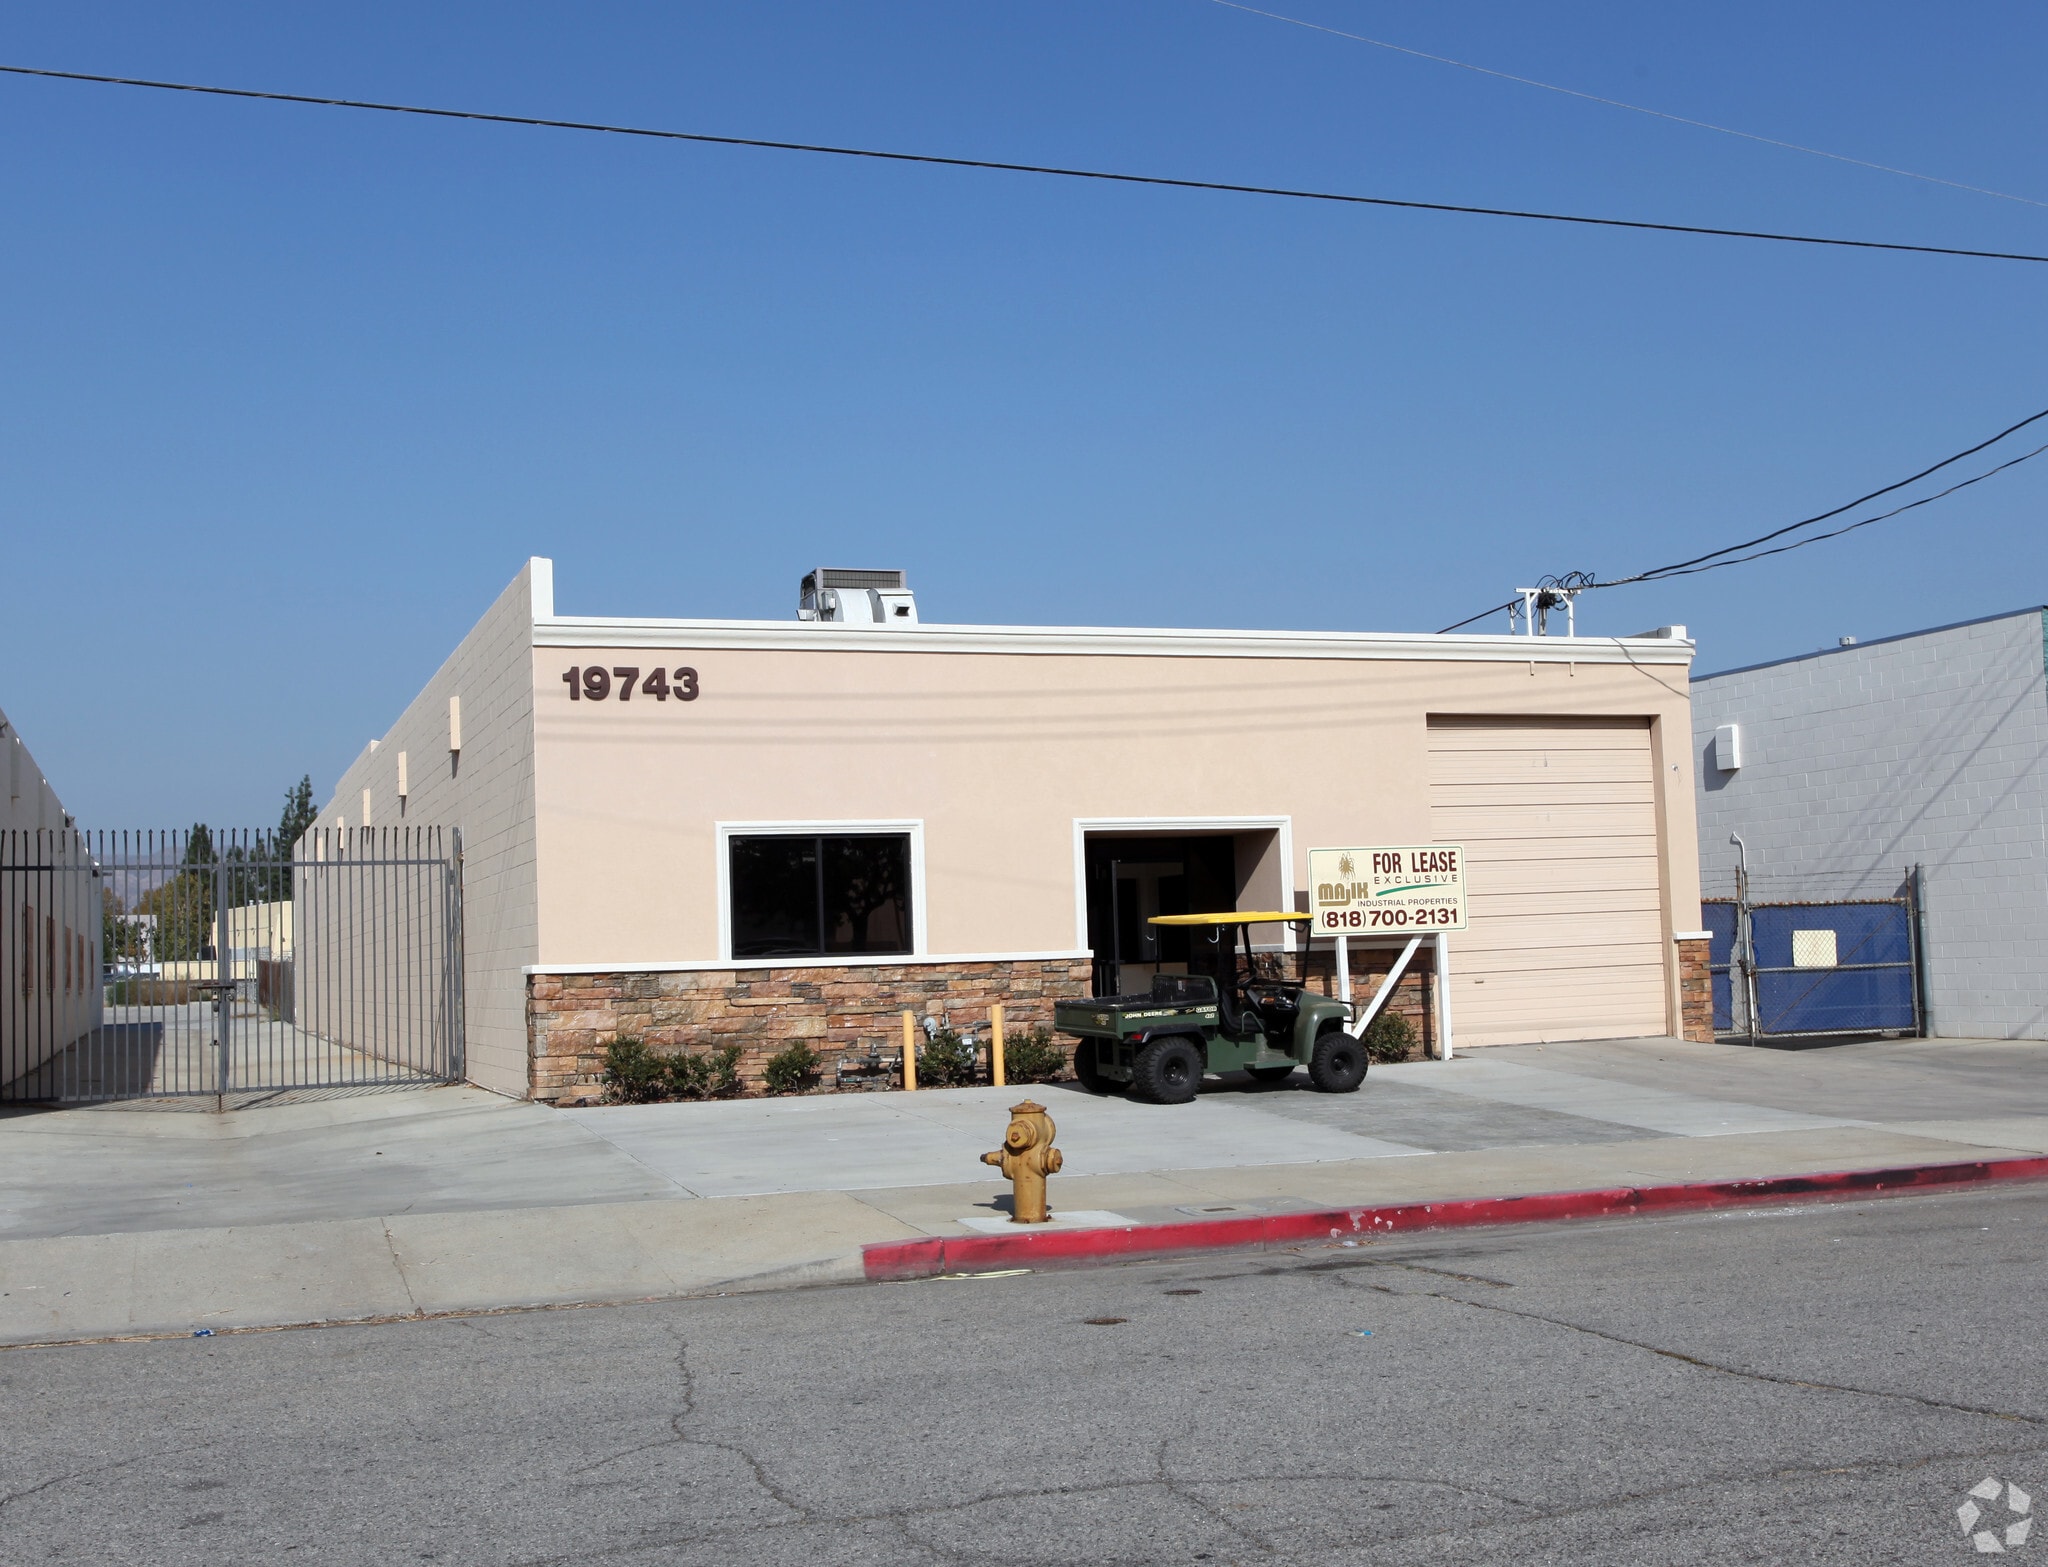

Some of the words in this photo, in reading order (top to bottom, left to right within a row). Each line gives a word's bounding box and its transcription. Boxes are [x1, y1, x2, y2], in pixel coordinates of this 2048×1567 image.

[562, 665, 700, 701] 19743
[1372, 852, 1402, 874] FOR
[1411, 851, 1457, 873] LEASE
[1373, 874, 1458, 885] EXCLUSIVE
[1357, 898, 1405, 907] INDUSTRIAL
[1408, 897, 1458, 906] PROPERTIES
